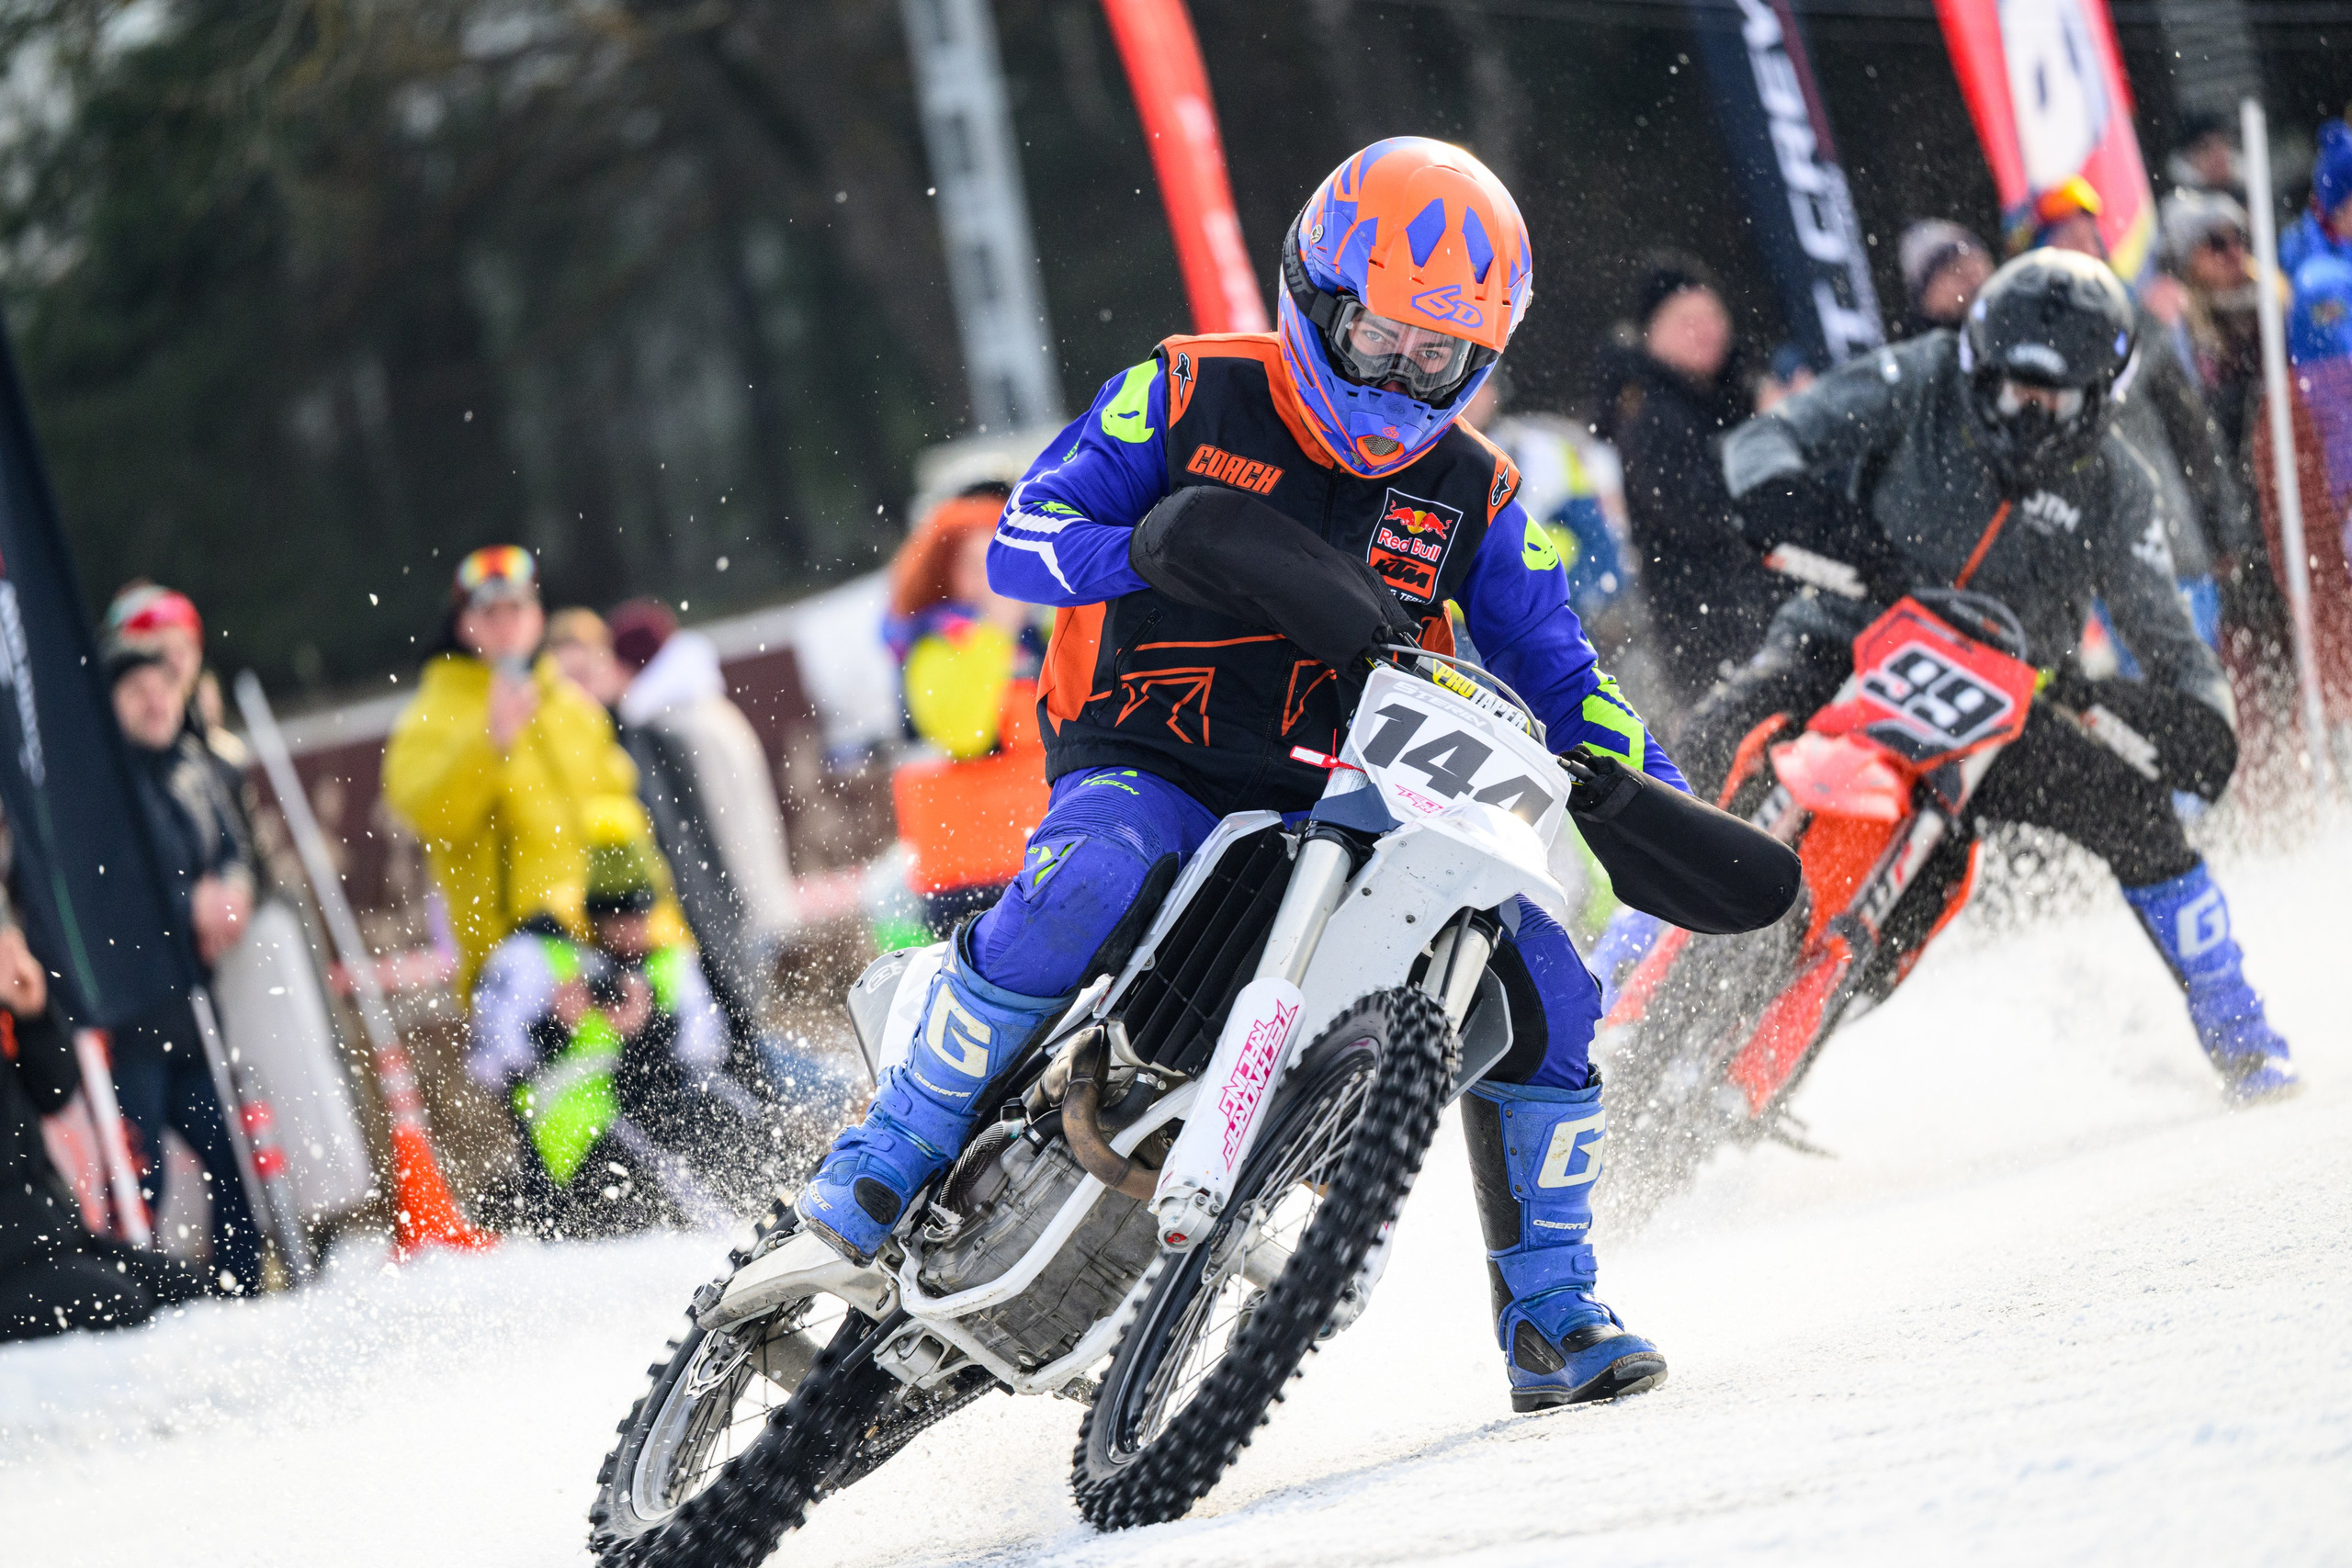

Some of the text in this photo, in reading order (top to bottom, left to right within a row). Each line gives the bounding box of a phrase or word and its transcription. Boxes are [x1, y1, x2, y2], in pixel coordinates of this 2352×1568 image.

[1411, 285, 1484, 328] 6D
[1185, 444, 1285, 496] COACH
[1377, 527, 1442, 562] Red Bull
[1373, 558, 1430, 589] KTM
[1862, 647, 2009, 742] 99
[1218, 1020, 1269, 1126] RACING
